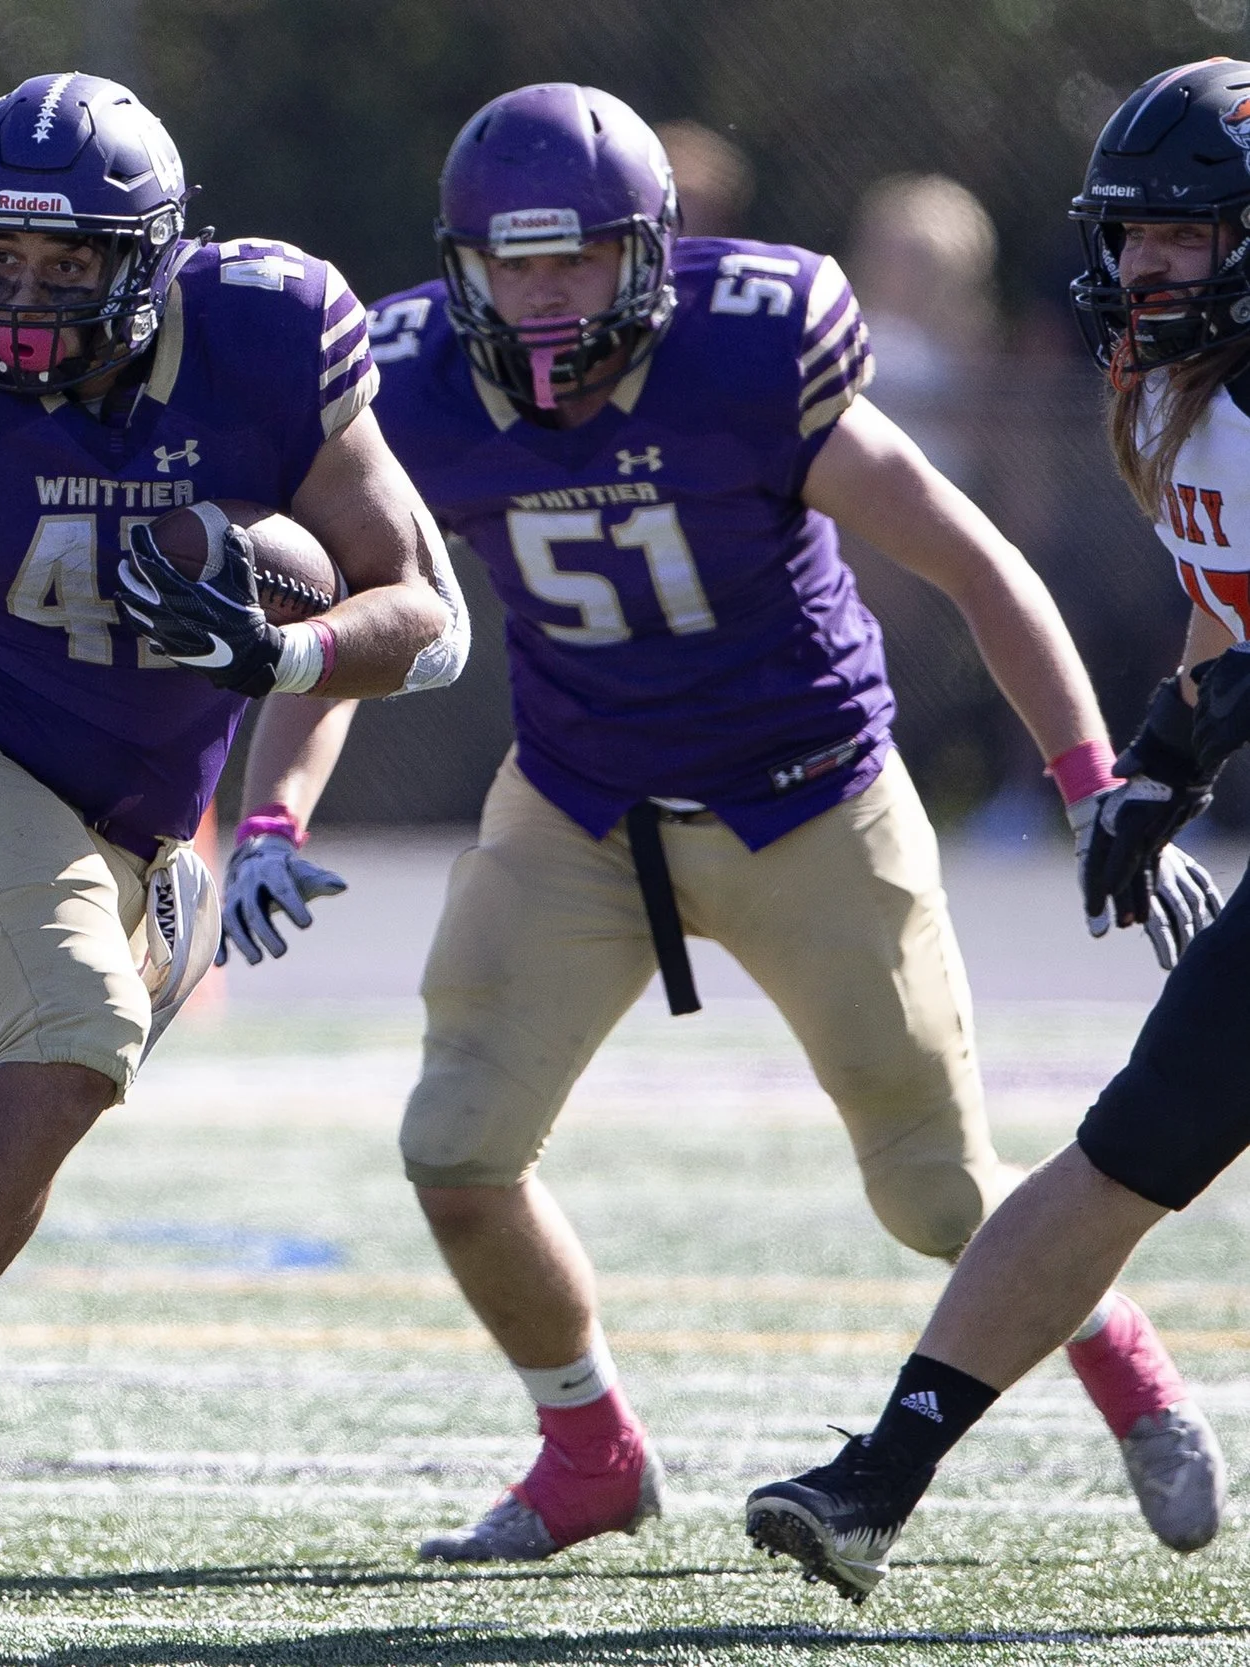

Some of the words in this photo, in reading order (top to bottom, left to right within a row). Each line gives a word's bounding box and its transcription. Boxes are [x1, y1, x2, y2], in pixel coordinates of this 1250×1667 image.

[710, 253, 800, 316] 51
[365, 297, 432, 363] 51
[35, 476, 195, 508] WHITTIER
[509, 482, 659, 510] WHITTIER
[6, 513, 180, 669] 4
[506, 502, 718, 647] 51
[900, 1396, 944, 1424] adidas
